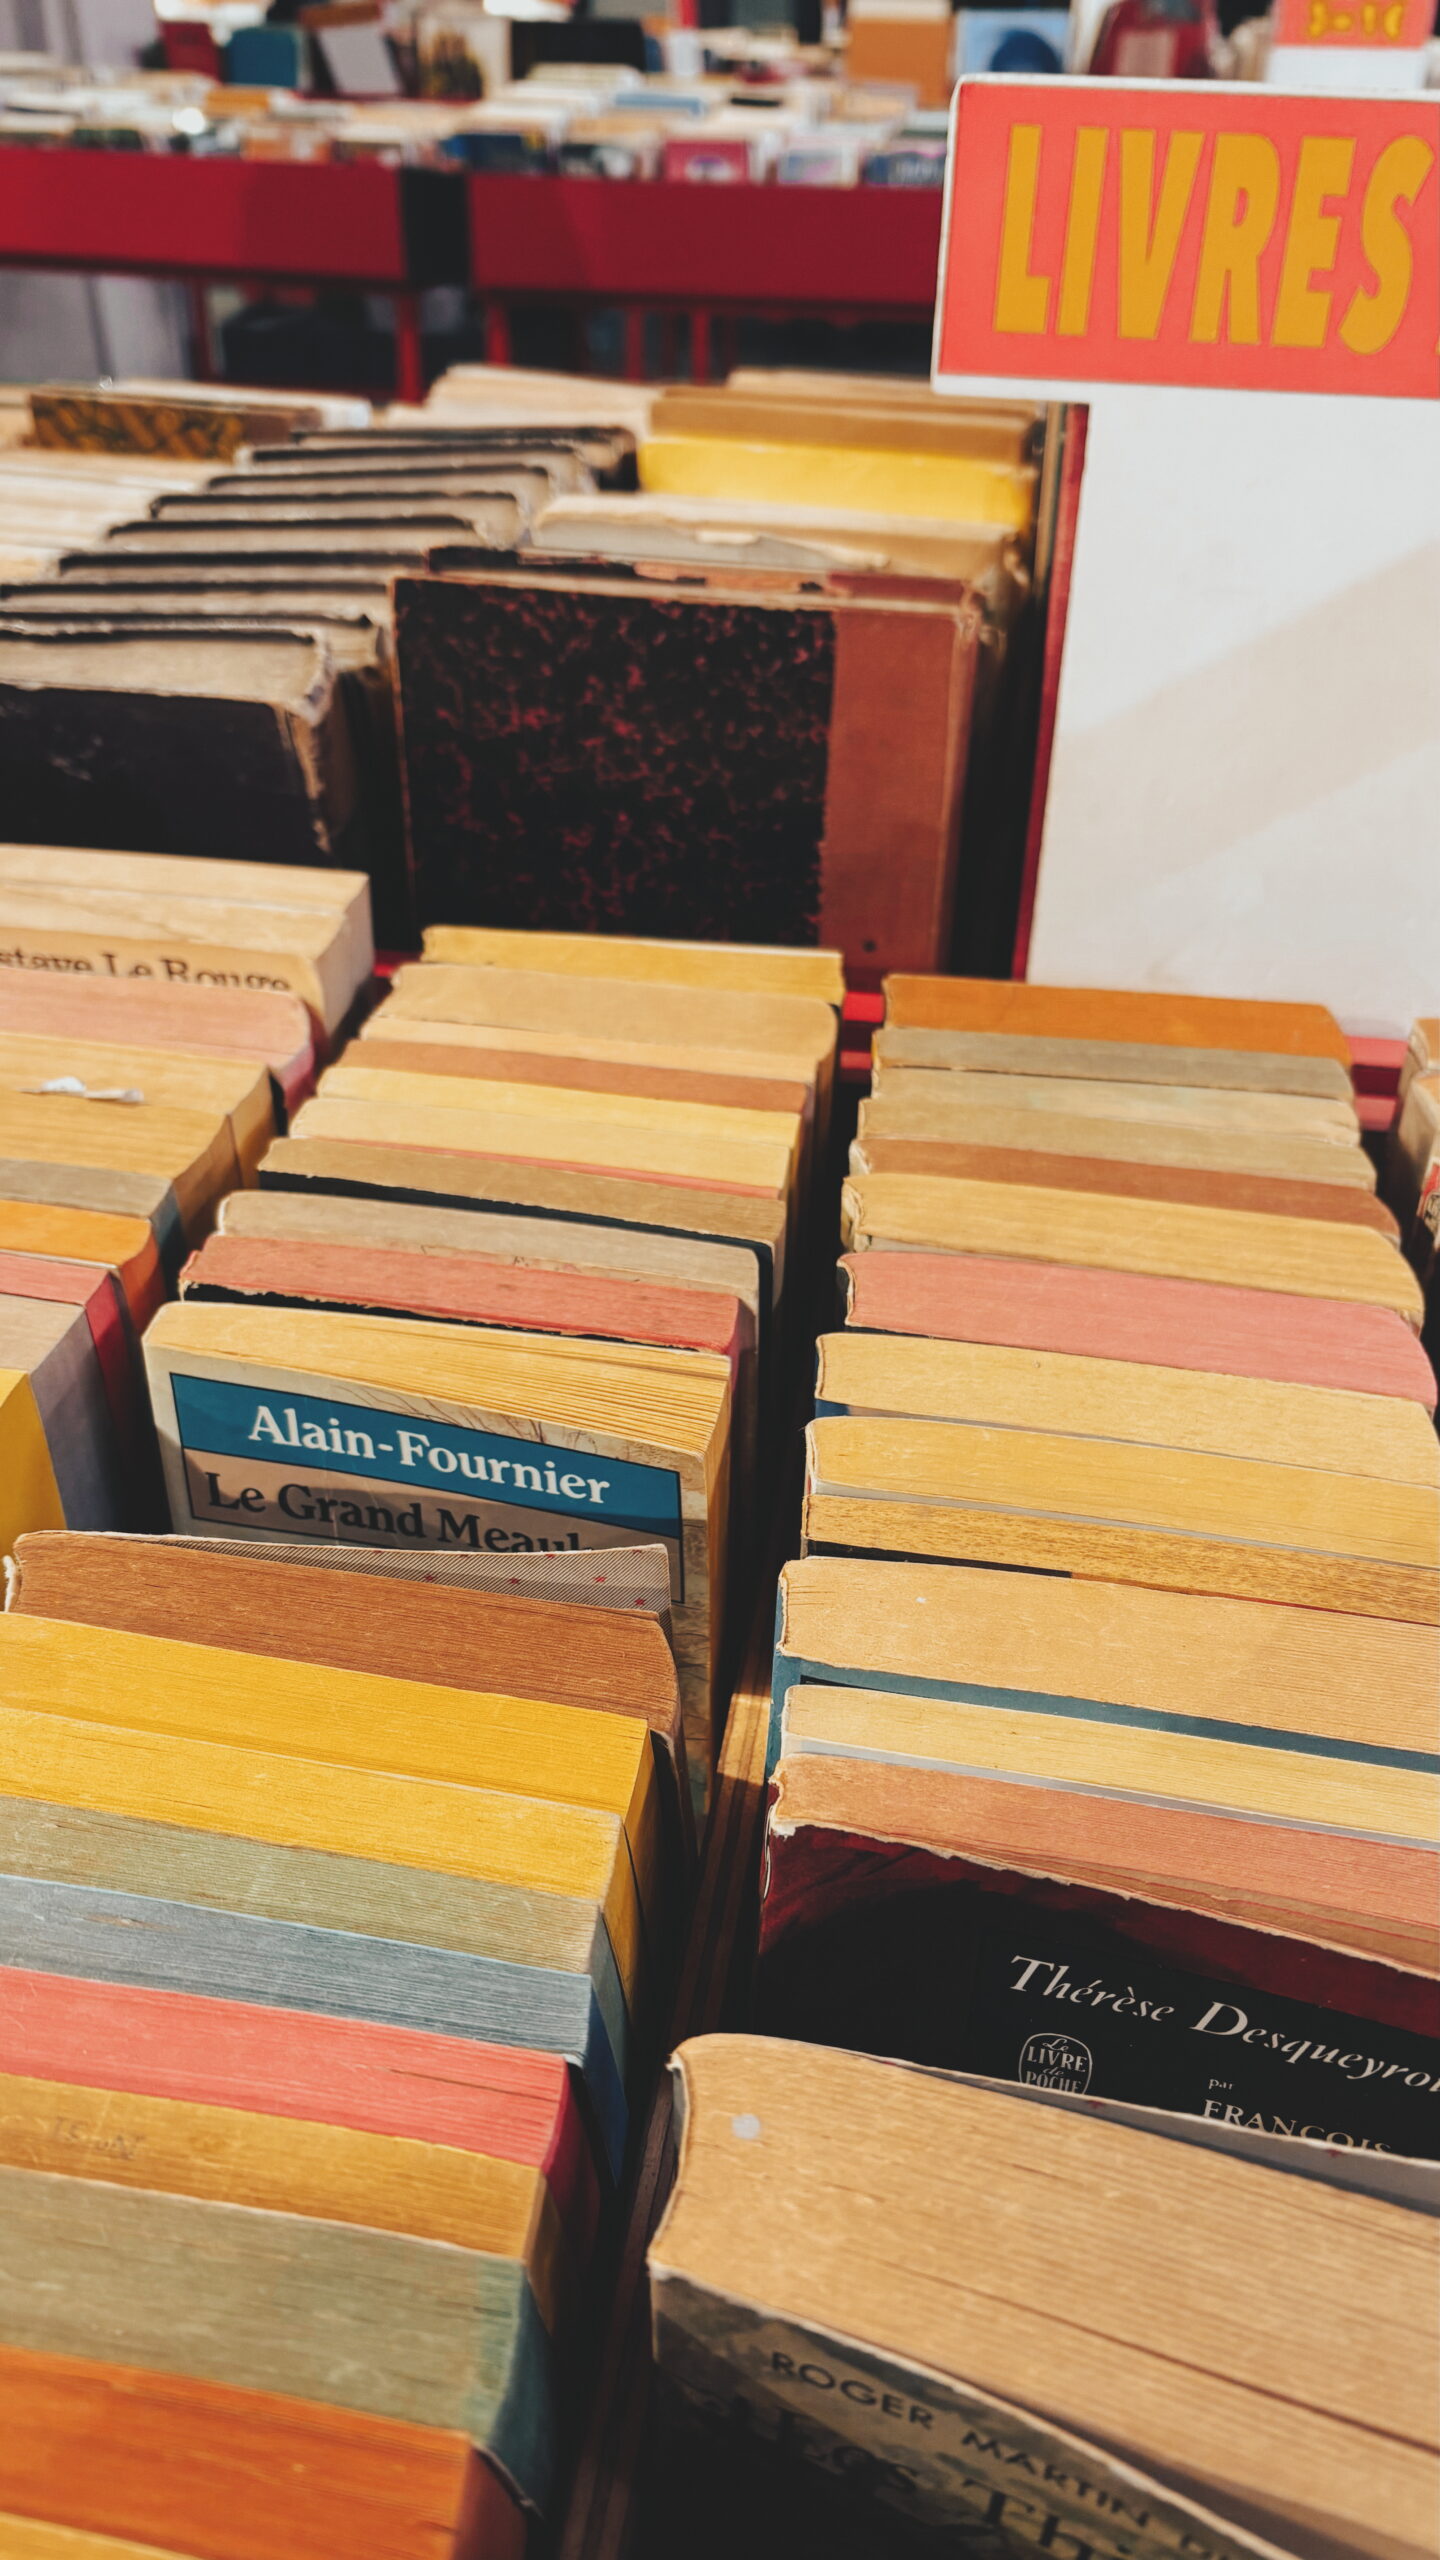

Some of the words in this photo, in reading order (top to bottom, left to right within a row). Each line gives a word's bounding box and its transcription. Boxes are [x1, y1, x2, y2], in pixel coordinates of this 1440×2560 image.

[993, 124, 1435, 356] LIVRES
[247, 1404, 611, 1504] Alain-Fournier
[206, 1471, 266, 1512] Le
[278, 1483, 427, 1539] Grand
[436, 1508, 594, 1553] Meaul
[1009, 1954, 1175, 2022] Thérèse
[1026, 2045, 1088, 2073] LIVRE
[1042, 2037, 1069, 2052] Le
[1207, 2078, 1235, 2091] par
[771, 2351, 936, 2431] ROGER
[961, 2430, 1150, 2528] MARTIN
